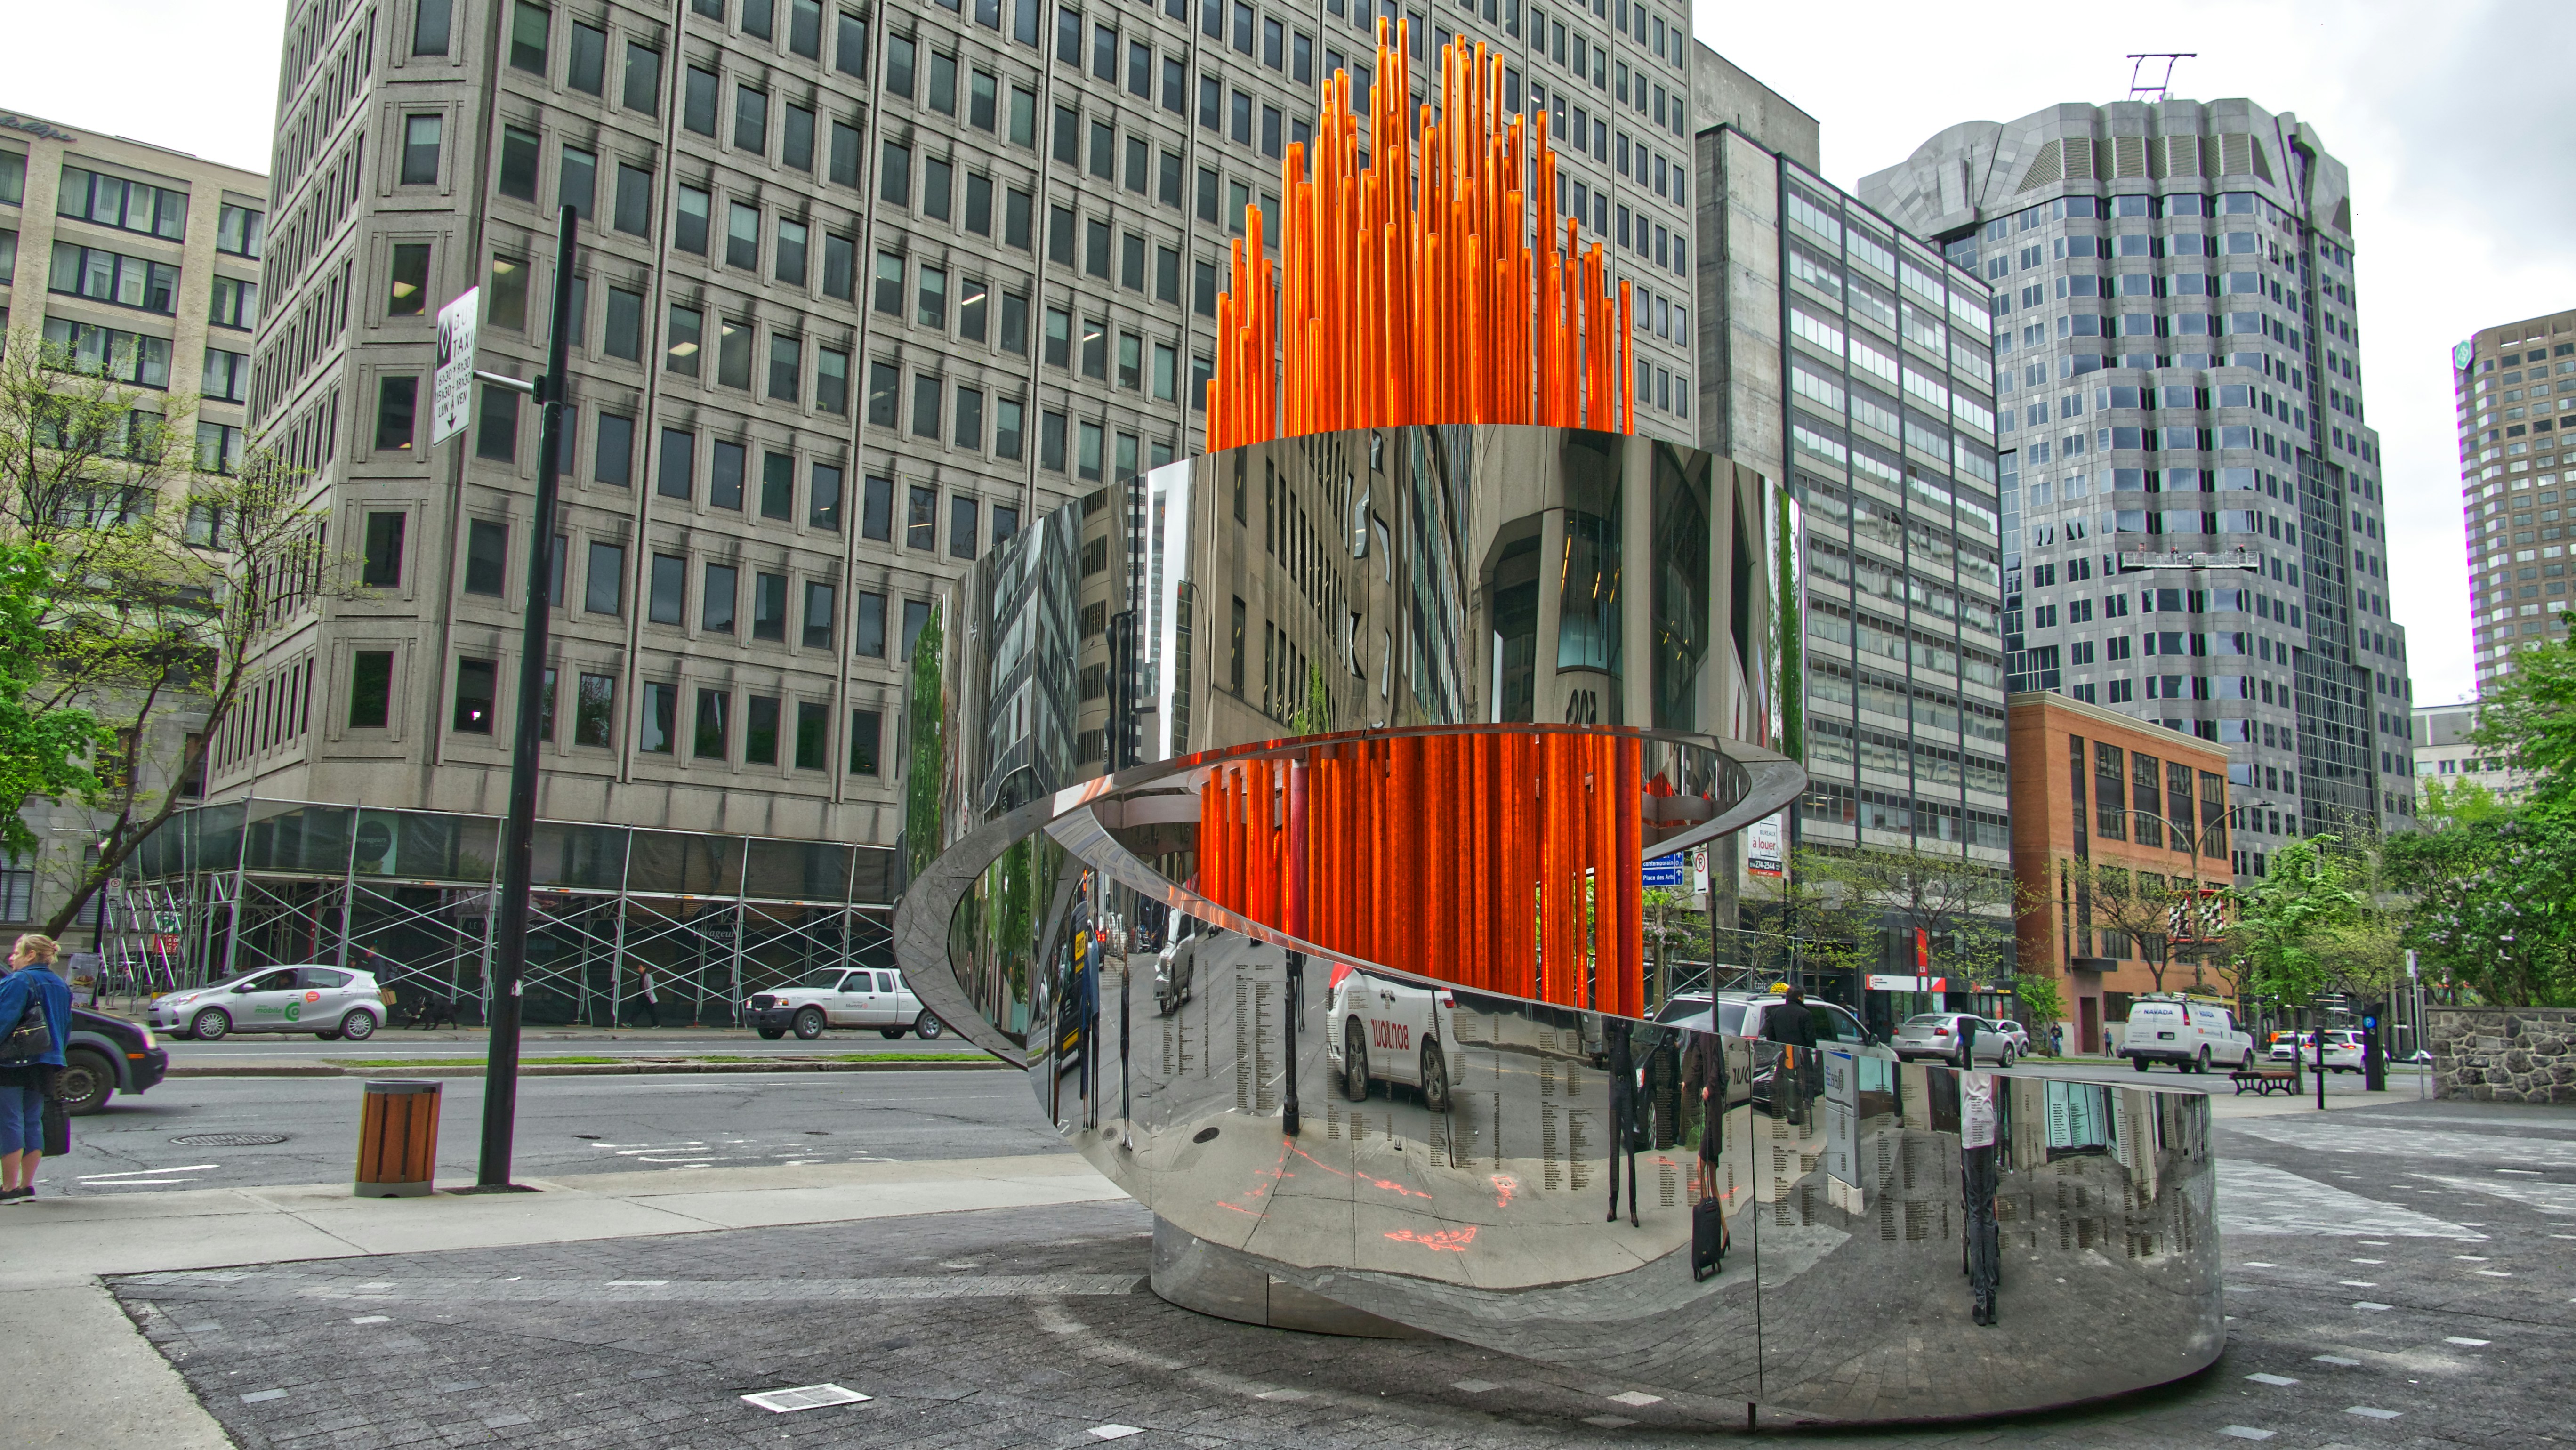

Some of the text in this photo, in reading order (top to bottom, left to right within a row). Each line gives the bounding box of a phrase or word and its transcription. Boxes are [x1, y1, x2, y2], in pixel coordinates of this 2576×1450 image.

[454, 302, 475, 331] BUS
[454, 329, 473, 358] TAXI
[438, 368, 452, 387] 6h30
[457, 356, 471, 373] 9h30
[436, 384, 451, 403] 15h30
[456, 372, 471, 391] 18h30
[438, 401, 449, 418] LUN
[457, 390, 467, 406] VEN
[1752, 836, 1776, 850] à louer
